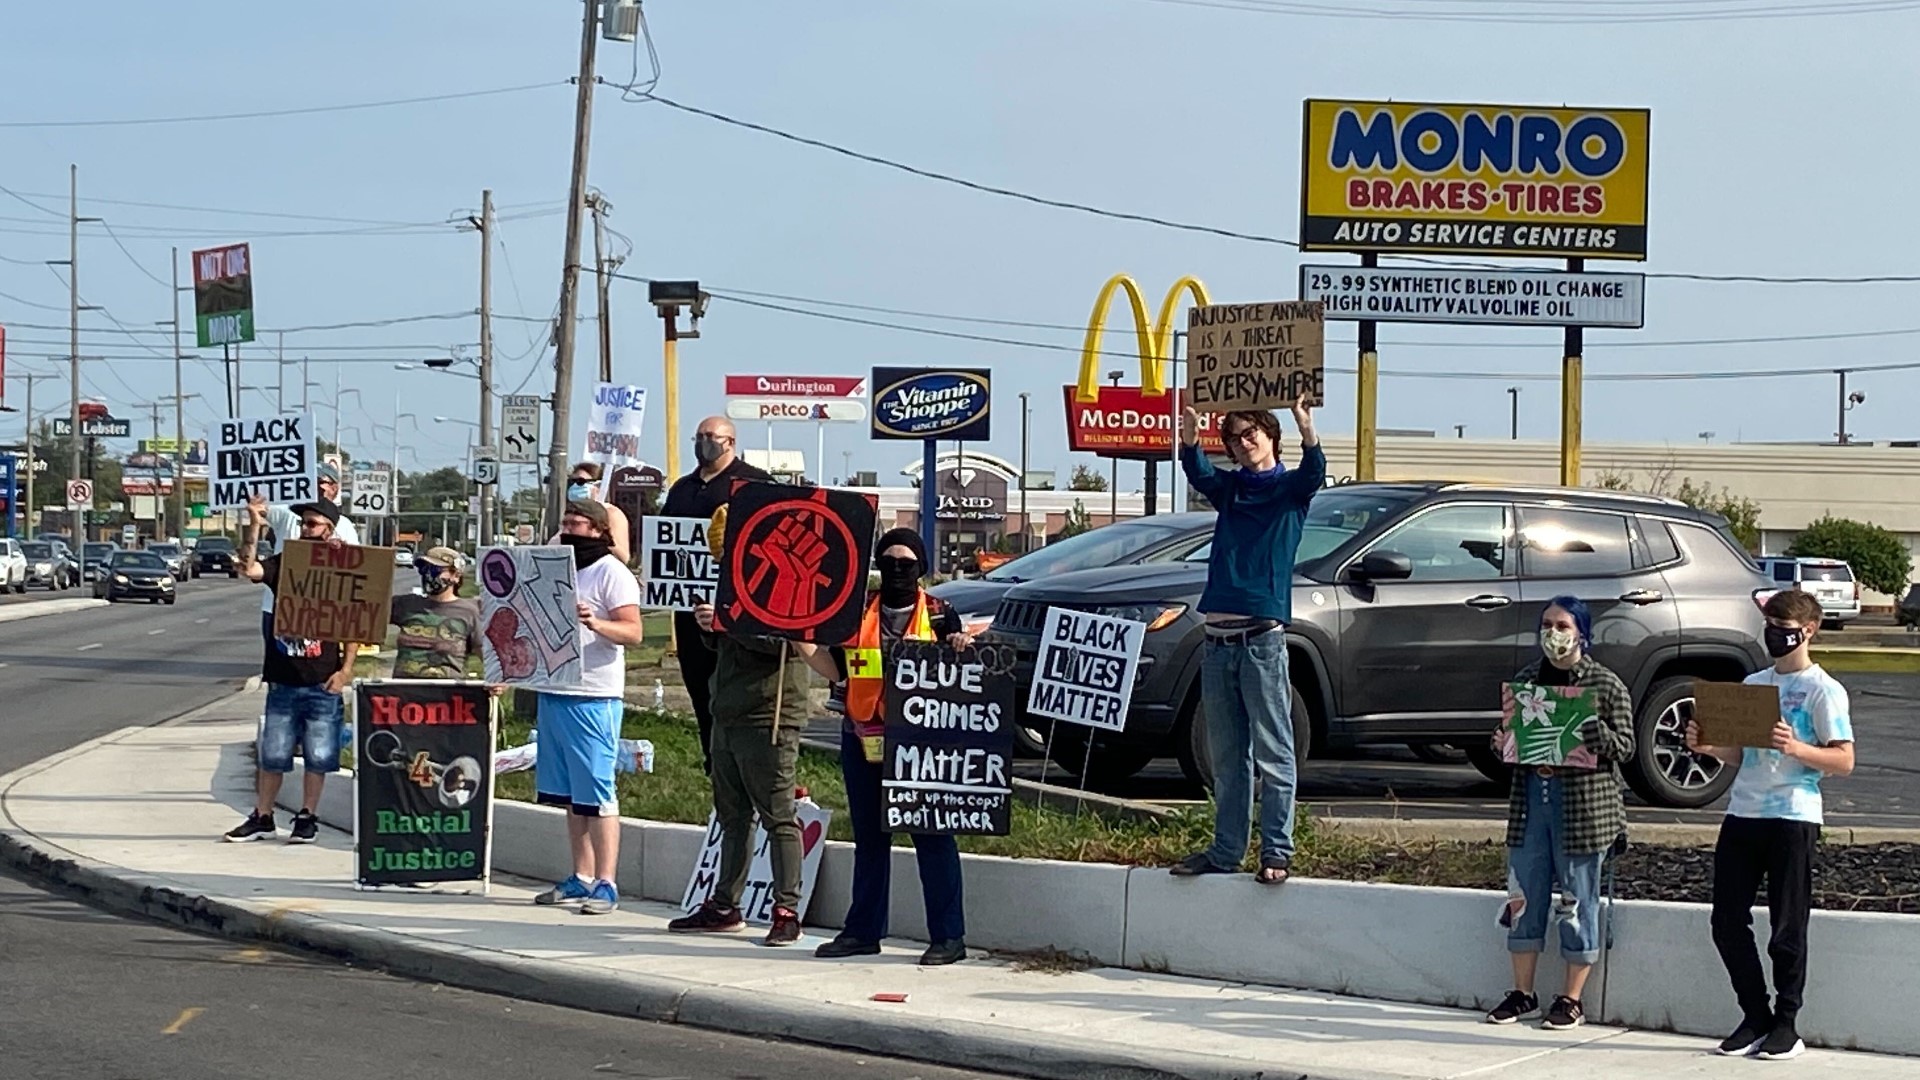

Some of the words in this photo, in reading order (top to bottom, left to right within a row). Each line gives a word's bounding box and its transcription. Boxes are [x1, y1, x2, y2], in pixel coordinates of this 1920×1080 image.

[1329, 109, 1626, 176] MONRO
[1334, 221, 1402, 242] AUTO
[1409, 223, 1505, 245] SERVICE
[1512, 226, 1617, 248] CENTERS
[201, 251, 225, 280] NOT
[1311, 274, 1366, 291] 29.99
[1369, 276, 1462, 294] SYNTHETIC
[1465, 279, 1517, 295] BLEND
[1522, 280, 1553, 296] OIL
[1557, 281, 1624, 298] CHANGE
[1321, 294, 1362, 311] HIGH
[1367, 296, 1443, 313] QUALITY
[1445, 297, 1540, 316] VALVOLINE
[1546, 301, 1575, 317] OIL
[208, 314, 243, 344] MORE
[1222, 330, 1233, 347] A
[1242, 324, 1295, 347] THREAT
[757, 377, 835, 395] Burlington
[897, 381, 978, 406] Vitamin
[1192, 367, 1323, 404] EVERYWHERE
[759, 402, 809, 420] petco
[888, 397, 971, 423] Shoppe
[1079, 409, 1225, 430] McDond's
[56, 421, 71, 434] Re
[82, 421, 128, 435] Lobster
[221, 417, 302, 446] BLACK
[15, 458, 48, 472] Wsh
[225, 447, 299, 477] LIVES
[478, 464, 493, 479] 51
[214, 477, 312, 506] MATTER
[355, 473, 388, 484] SPEED
[358, 483, 383, 492] LIMIT
[353, 493, 385, 511] 40
[935, 493, 994, 511] JARED
[657, 520, 707, 547] BLA
[309, 542, 364, 570] END
[660, 547, 720, 579] LIVE
[646, 581, 715, 608] MATT
[1055, 614, 1131, 652] BLACK
[895, 659, 984, 693] BLUE
[1051, 646, 1120, 689] LIVES
[370, 695, 477, 725] Honk
[903, 696, 1001, 732] CRIMES
[1032, 682, 1123, 726] MATTER
[408, 751, 433, 788] 4
[925, 793, 941, 805] up
[942, 792, 965, 806] the
[376, 809, 472, 835] Racial
[887, 804, 930, 829] Boot
[368, 846, 476, 871] Justice
